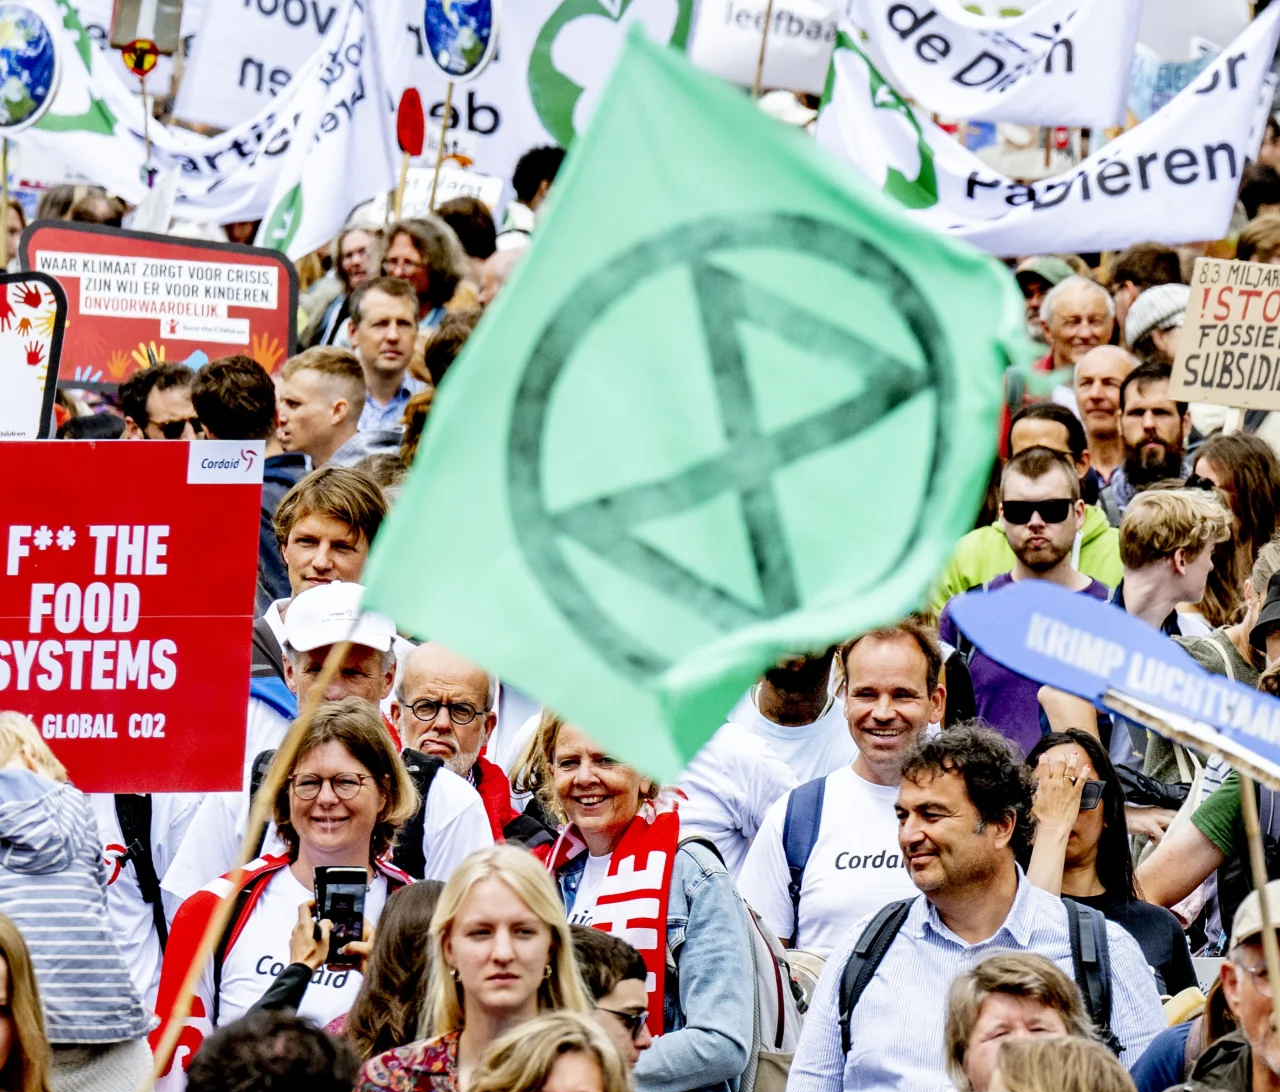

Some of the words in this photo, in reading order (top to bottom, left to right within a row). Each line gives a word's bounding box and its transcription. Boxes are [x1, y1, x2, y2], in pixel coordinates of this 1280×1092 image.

[887, 3, 952, 64] de
[40, 255, 77, 272] WAAR
[82, 260, 138, 277] KLIMAAT
[142, 263, 184, 279] ZORGT
[187, 267, 224, 282] VOOR
[85, 277, 112, 293] ZIJN
[116, 281, 139, 296] WIJ
[143, 283, 160, 297] ER
[165, 285, 199, 300] VOOR
[201, 457, 241, 470] Cordaid
[89, 525, 171, 576] THE
[29, 582, 141, 634] FOOD
[1025, 611, 1126, 679] KRIMP
[42, 713, 118, 739] GLOBAL
